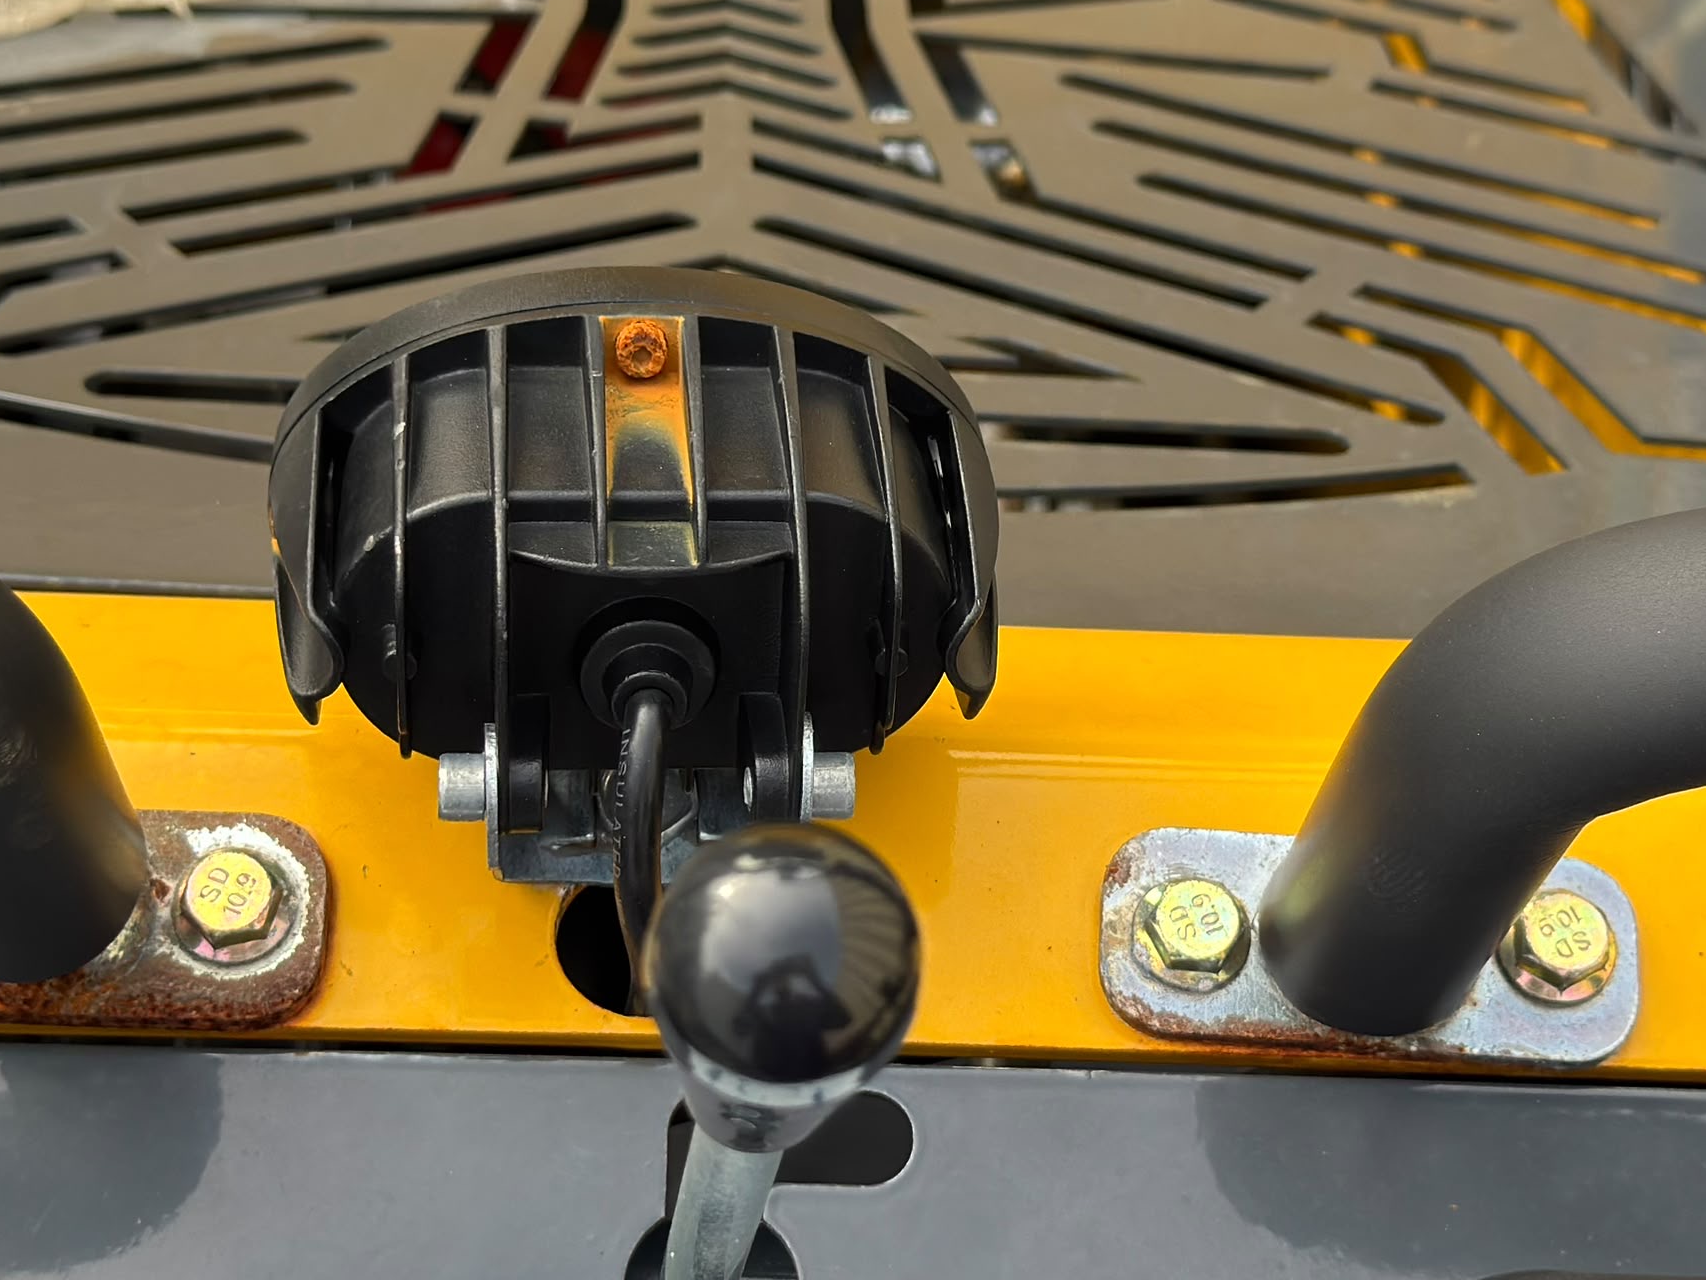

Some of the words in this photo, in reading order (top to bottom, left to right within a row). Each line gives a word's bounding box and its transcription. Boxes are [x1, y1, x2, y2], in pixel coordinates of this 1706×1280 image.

[199, 867, 230, 903] SD
[222, 872, 257, 915] 10.9
[1169, 905, 1197, 941] SD
[1191, 893, 1228, 937] 10.9
[1539, 905, 1583, 938] 10.9
[1555, 930, 1592, 958] SD
